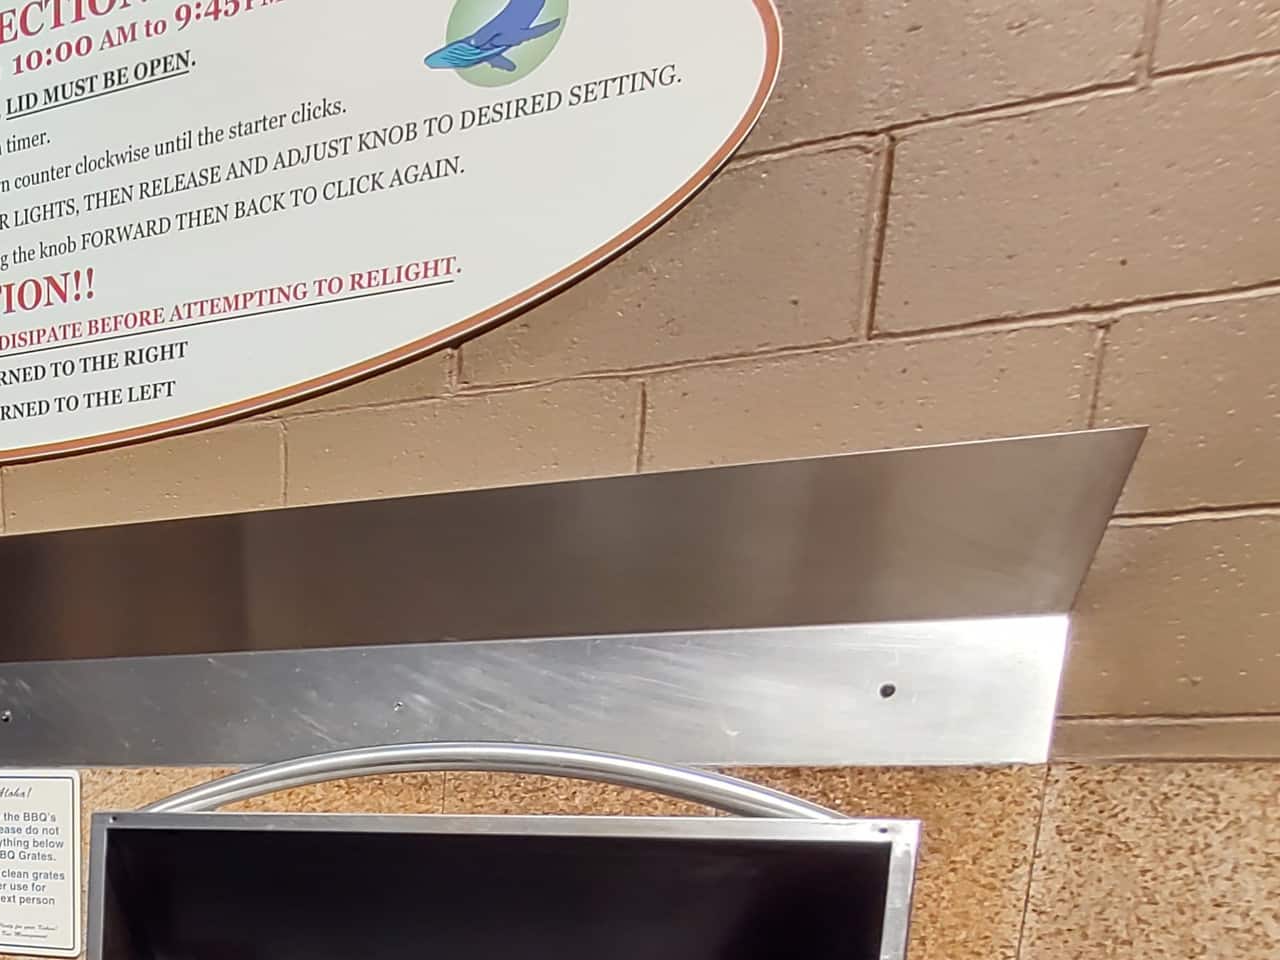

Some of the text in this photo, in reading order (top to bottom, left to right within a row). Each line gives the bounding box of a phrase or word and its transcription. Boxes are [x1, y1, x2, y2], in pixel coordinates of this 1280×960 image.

[13, 36, 92, 75] 10:00
[99, 22, 137, 51] AM
[144, 20, 166, 37] to
[6, 92, 38, 115] LID
[43, 75, 98, 105] MUST
[103, 66, 129, 89] BE
[134, 50, 196, 80] OPEN.
[7, 132, 50, 153] timer.
[14, 198, 79, 227] LIGHTS,
[83, 185, 133, 211] THEN
[139, 165, 221, 200] RELEASE
[227, 156, 268, 181] AND
[274, 136, 352, 170] ADJUST
[359, 122, 417, 152] KNOB
[423, 114, 453, 137] TO
[460, 91, 562, 130] DESIRED
[569, 64, 681, 106] SETTING.
[15, 165, 72, 189] counter
[75, 145, 149, 175] clockwise
[155, 130, 192, 156] until
[198, 126, 224, 146] the
[229, 114, 287, 139] starter
[292, 98, 346, 124] clicks.
[11, 246, 35, 264] the
[39, 236, 76, 259] knob
[80, 217, 171, 250] FORWARD
[175, 204, 229, 230] THEN
[234, 192, 285, 219] BACK
[289, 186, 317, 207] TO
[322, 171, 384, 200] CLICK
[388, 156, 464, 188] AGAIN.
[87, 307, 165, 336] BEFORE
[168, 283, 308, 322] ATTEMPTING
[312, 277, 343, 296] TO
[349, 256, 461, 291] RELIGHT.
[50, 360, 75, 378] TO
[79, 353, 119, 373] THE
[124, 341, 188, 366] RIGHT
[54, 395, 79, 412] TO
[83, 389, 122, 408] THE
[128, 381, 176, 402] LEFT
[4, 812, 19, 821] the
[24, 813, 56, 822] BBQ's
[26, 825, 38, 835] do
[42, 827, 59, 835] not
[19, 851, 56, 861] Grates.
[33, 839, 64, 848] below
[1, 869, 29, 878] clean
[32, 870, 65, 881] grates
[31, 883, 46, 892] for
[19, 896, 55, 905] person
